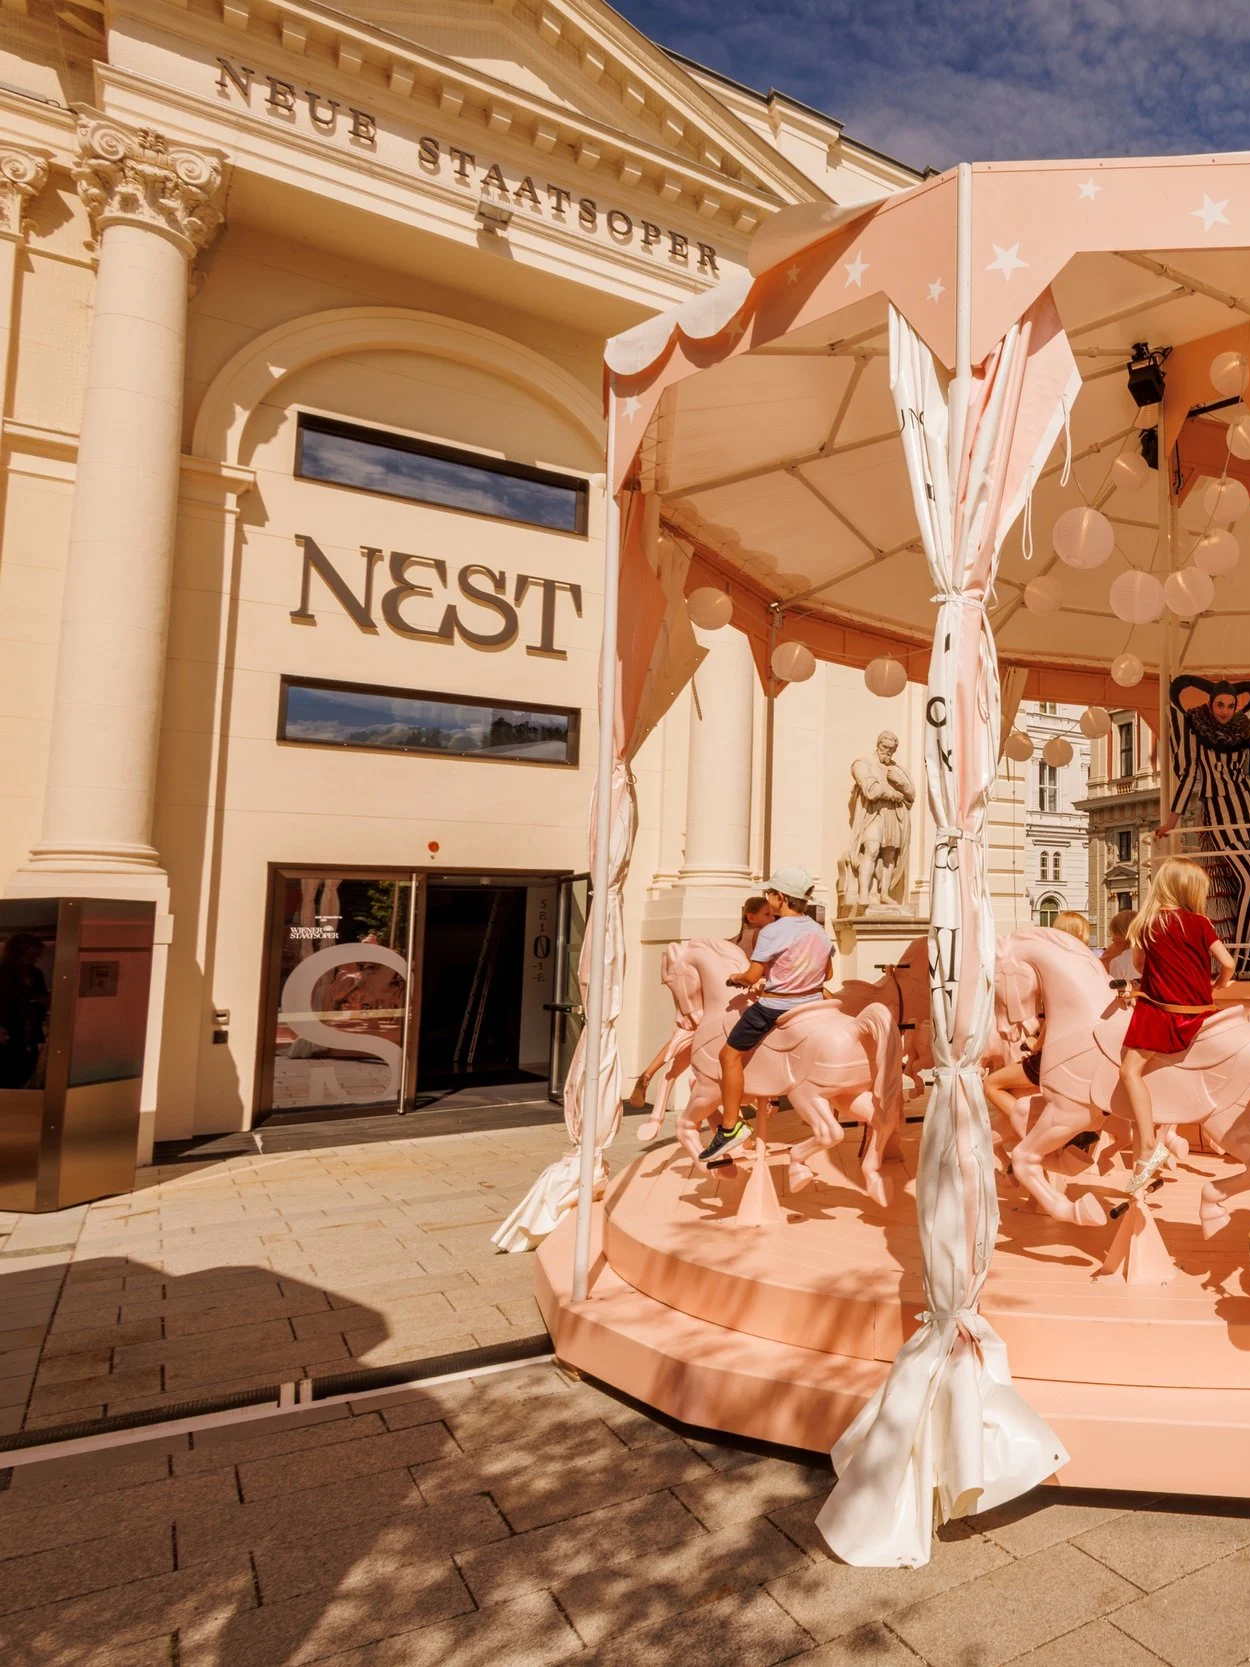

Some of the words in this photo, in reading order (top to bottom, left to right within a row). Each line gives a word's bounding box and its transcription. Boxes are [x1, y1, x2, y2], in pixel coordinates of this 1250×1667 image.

[215, 57, 377, 144] NEUE
[418, 137, 720, 271] STAATSOPER
[289, 533, 583, 656] NEST
[290, 926, 323, 934] WIENER
